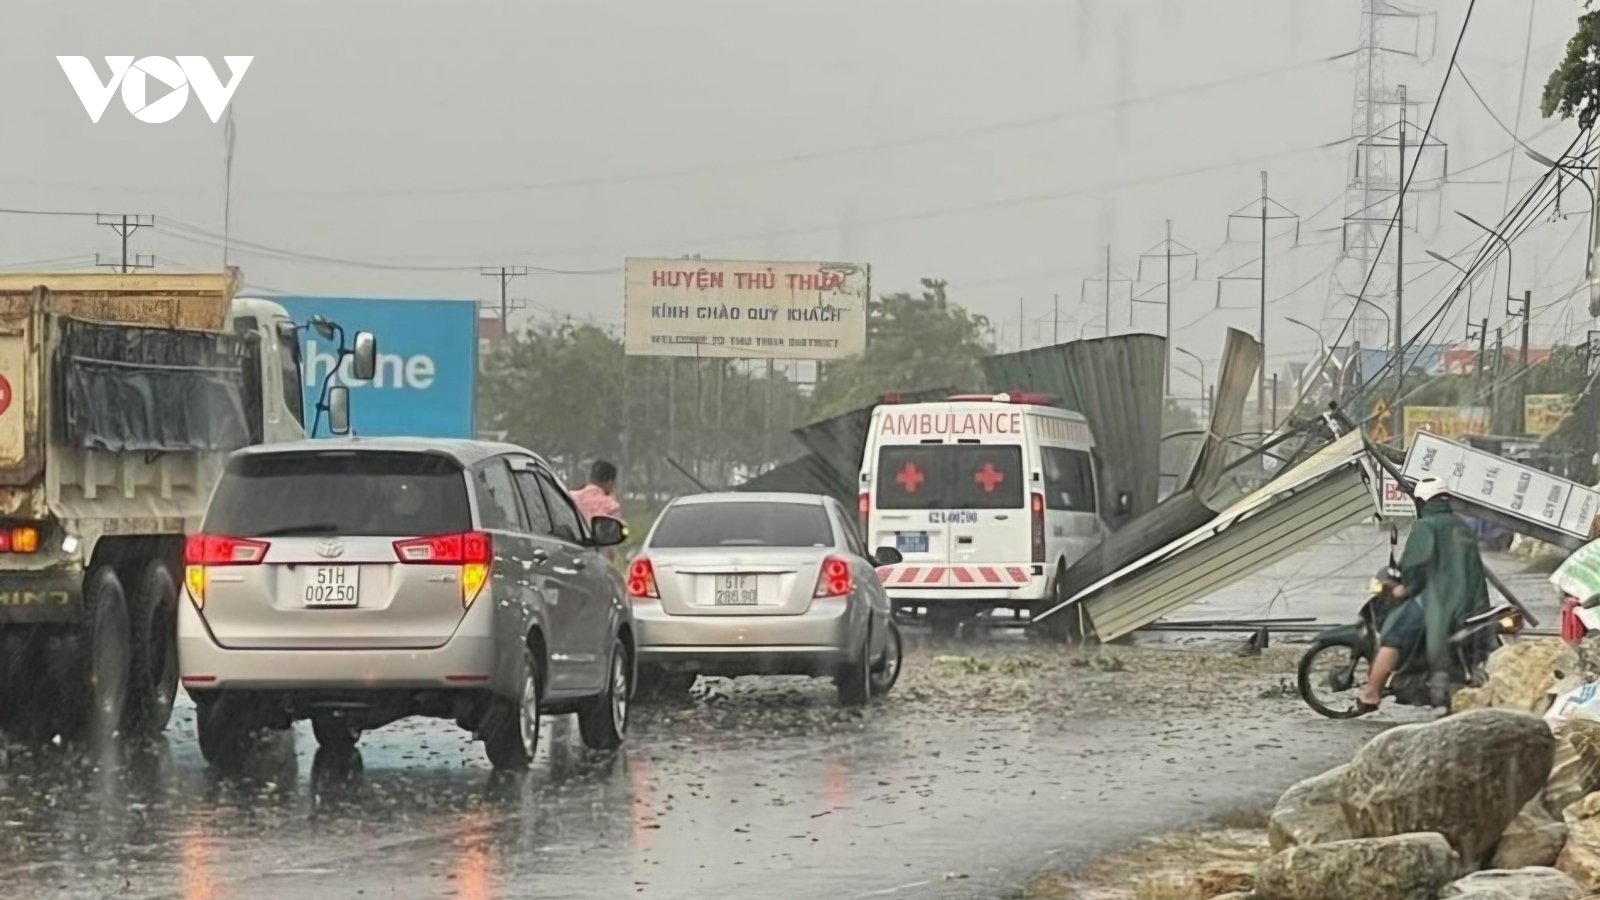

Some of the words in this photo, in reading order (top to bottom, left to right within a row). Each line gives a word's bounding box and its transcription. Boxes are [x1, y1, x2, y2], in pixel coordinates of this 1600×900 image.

[652, 268, 724, 291] HUYỆN
[881, 412, 1021, 435] AMBULANCE
[317, 567, 345, 584] 51H
